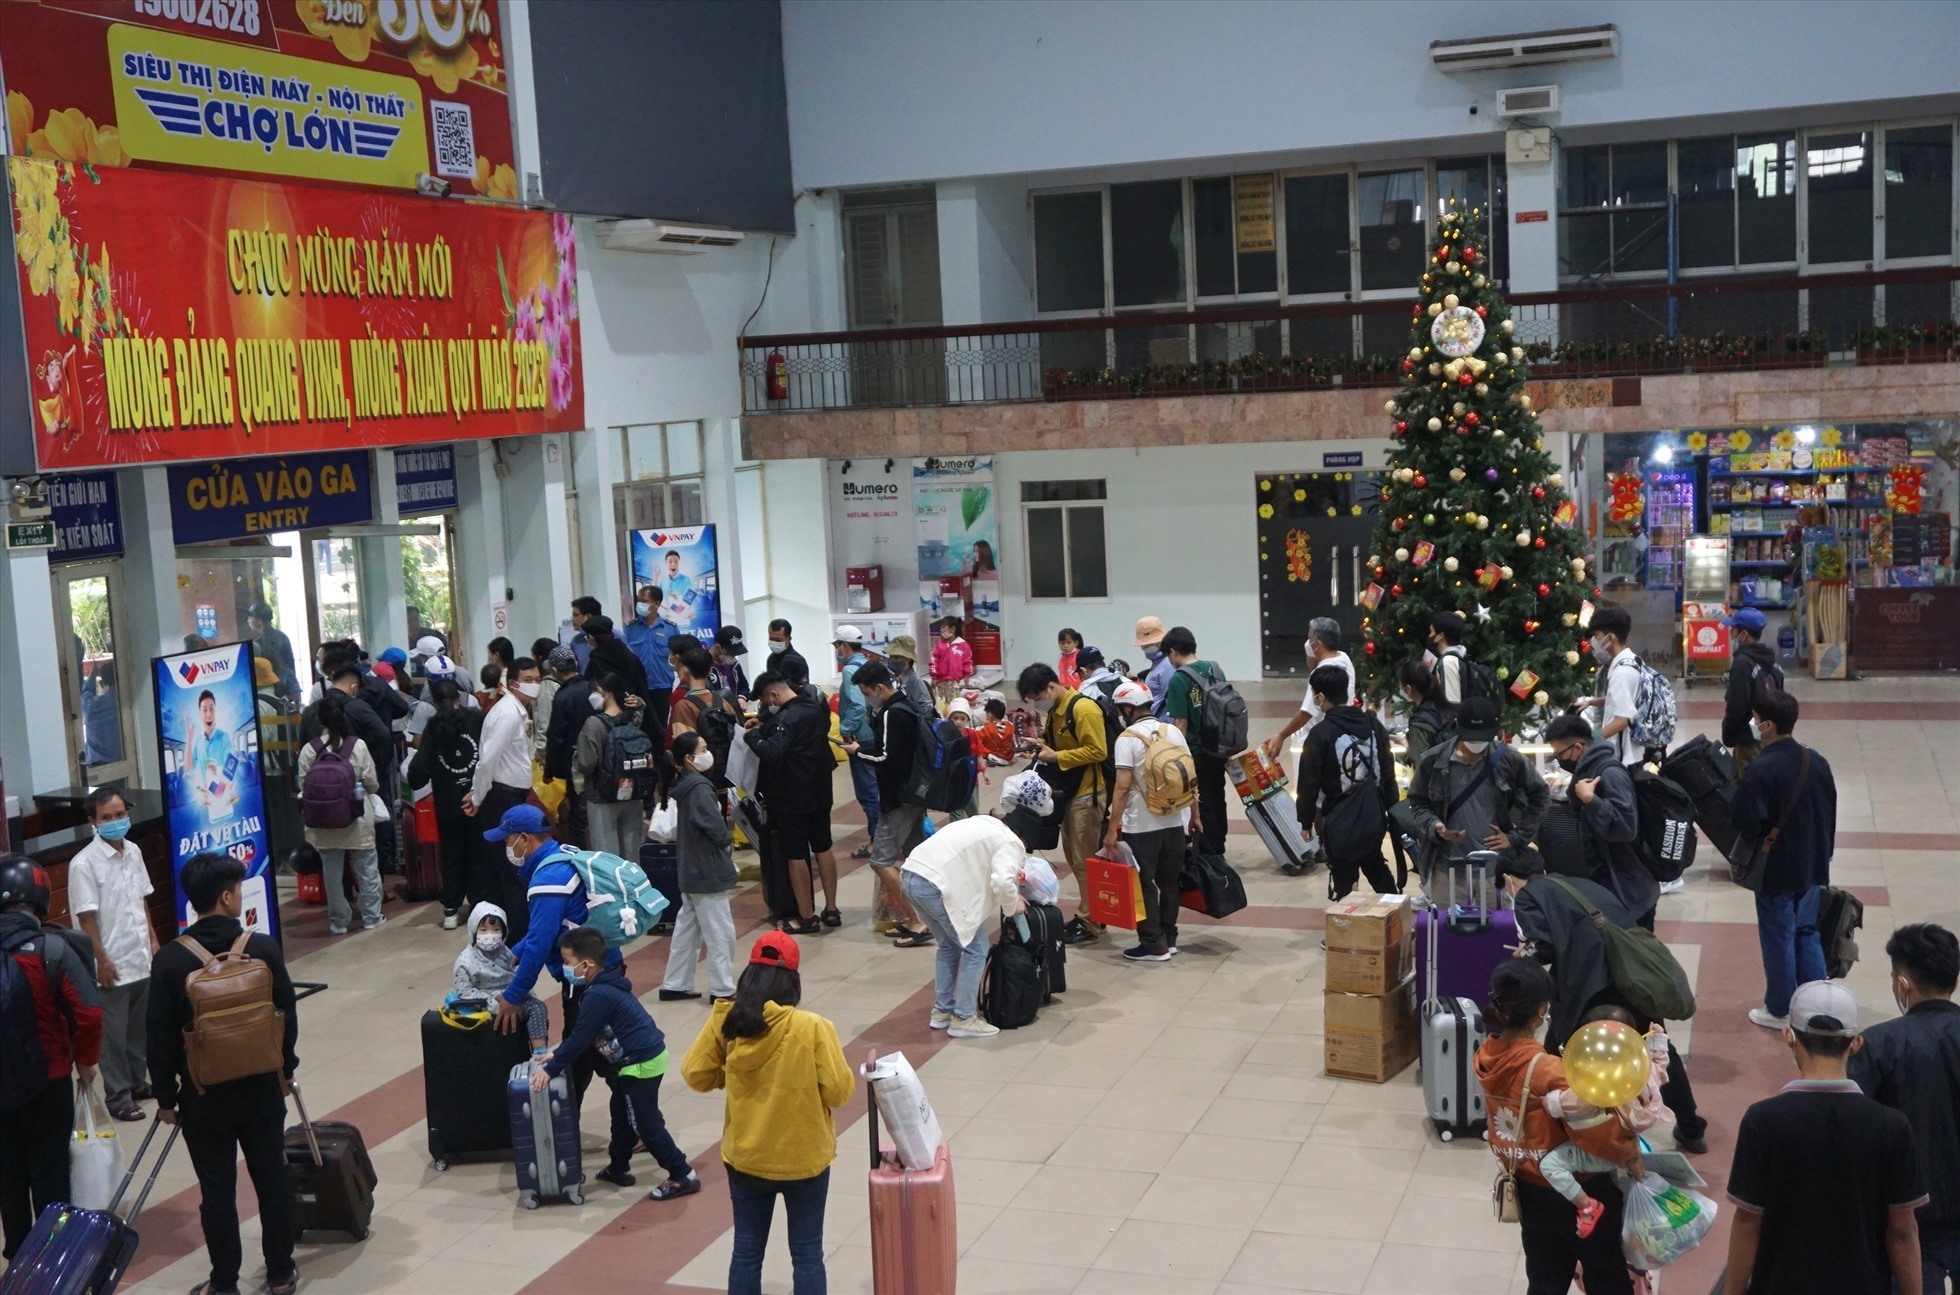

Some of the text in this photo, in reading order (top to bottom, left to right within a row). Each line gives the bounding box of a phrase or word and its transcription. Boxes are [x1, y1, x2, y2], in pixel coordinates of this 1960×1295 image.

[123, 52, 173, 82] SIÊU
[177, 62, 213, 93] THỊ
[217, 69, 266, 99] ĐIỆN
[271, 78, 310, 103] MÁY
[328, 87, 361, 114] NỘI
[365, 94, 405, 118] THẤT
[203, 100, 353, 154] CHỢ LỚN
[227, 222, 453, 299] CHÚC MỪNG NĂM MỚI
[102, 307, 546, 437] MỪNG ĐẢNG QUANG VINH, MỪNG XUÂN QUÝ MÃO 2023
[187, 462, 249, 511] CỬA
[255, 460, 313, 502] VÀO
[319, 463, 357, 496] GA
[843, 482, 898, 495] Humero
[17, 524, 44, 536] EXIT
[66, 517, 91, 551] KIỂM
[90, 518, 115, 548] SOÁT
[244, 506, 310, 532] ENTRY
[668, 532, 695, 541] VNPAY
[200, 658, 230, 674] VNPAY
[179, 831, 210, 856] ĐẶT
[232, 815, 262, 839] TÀU
[1660, 818, 1677, 859] FASHION
[1672, 821, 1689, 860] INSIDER
